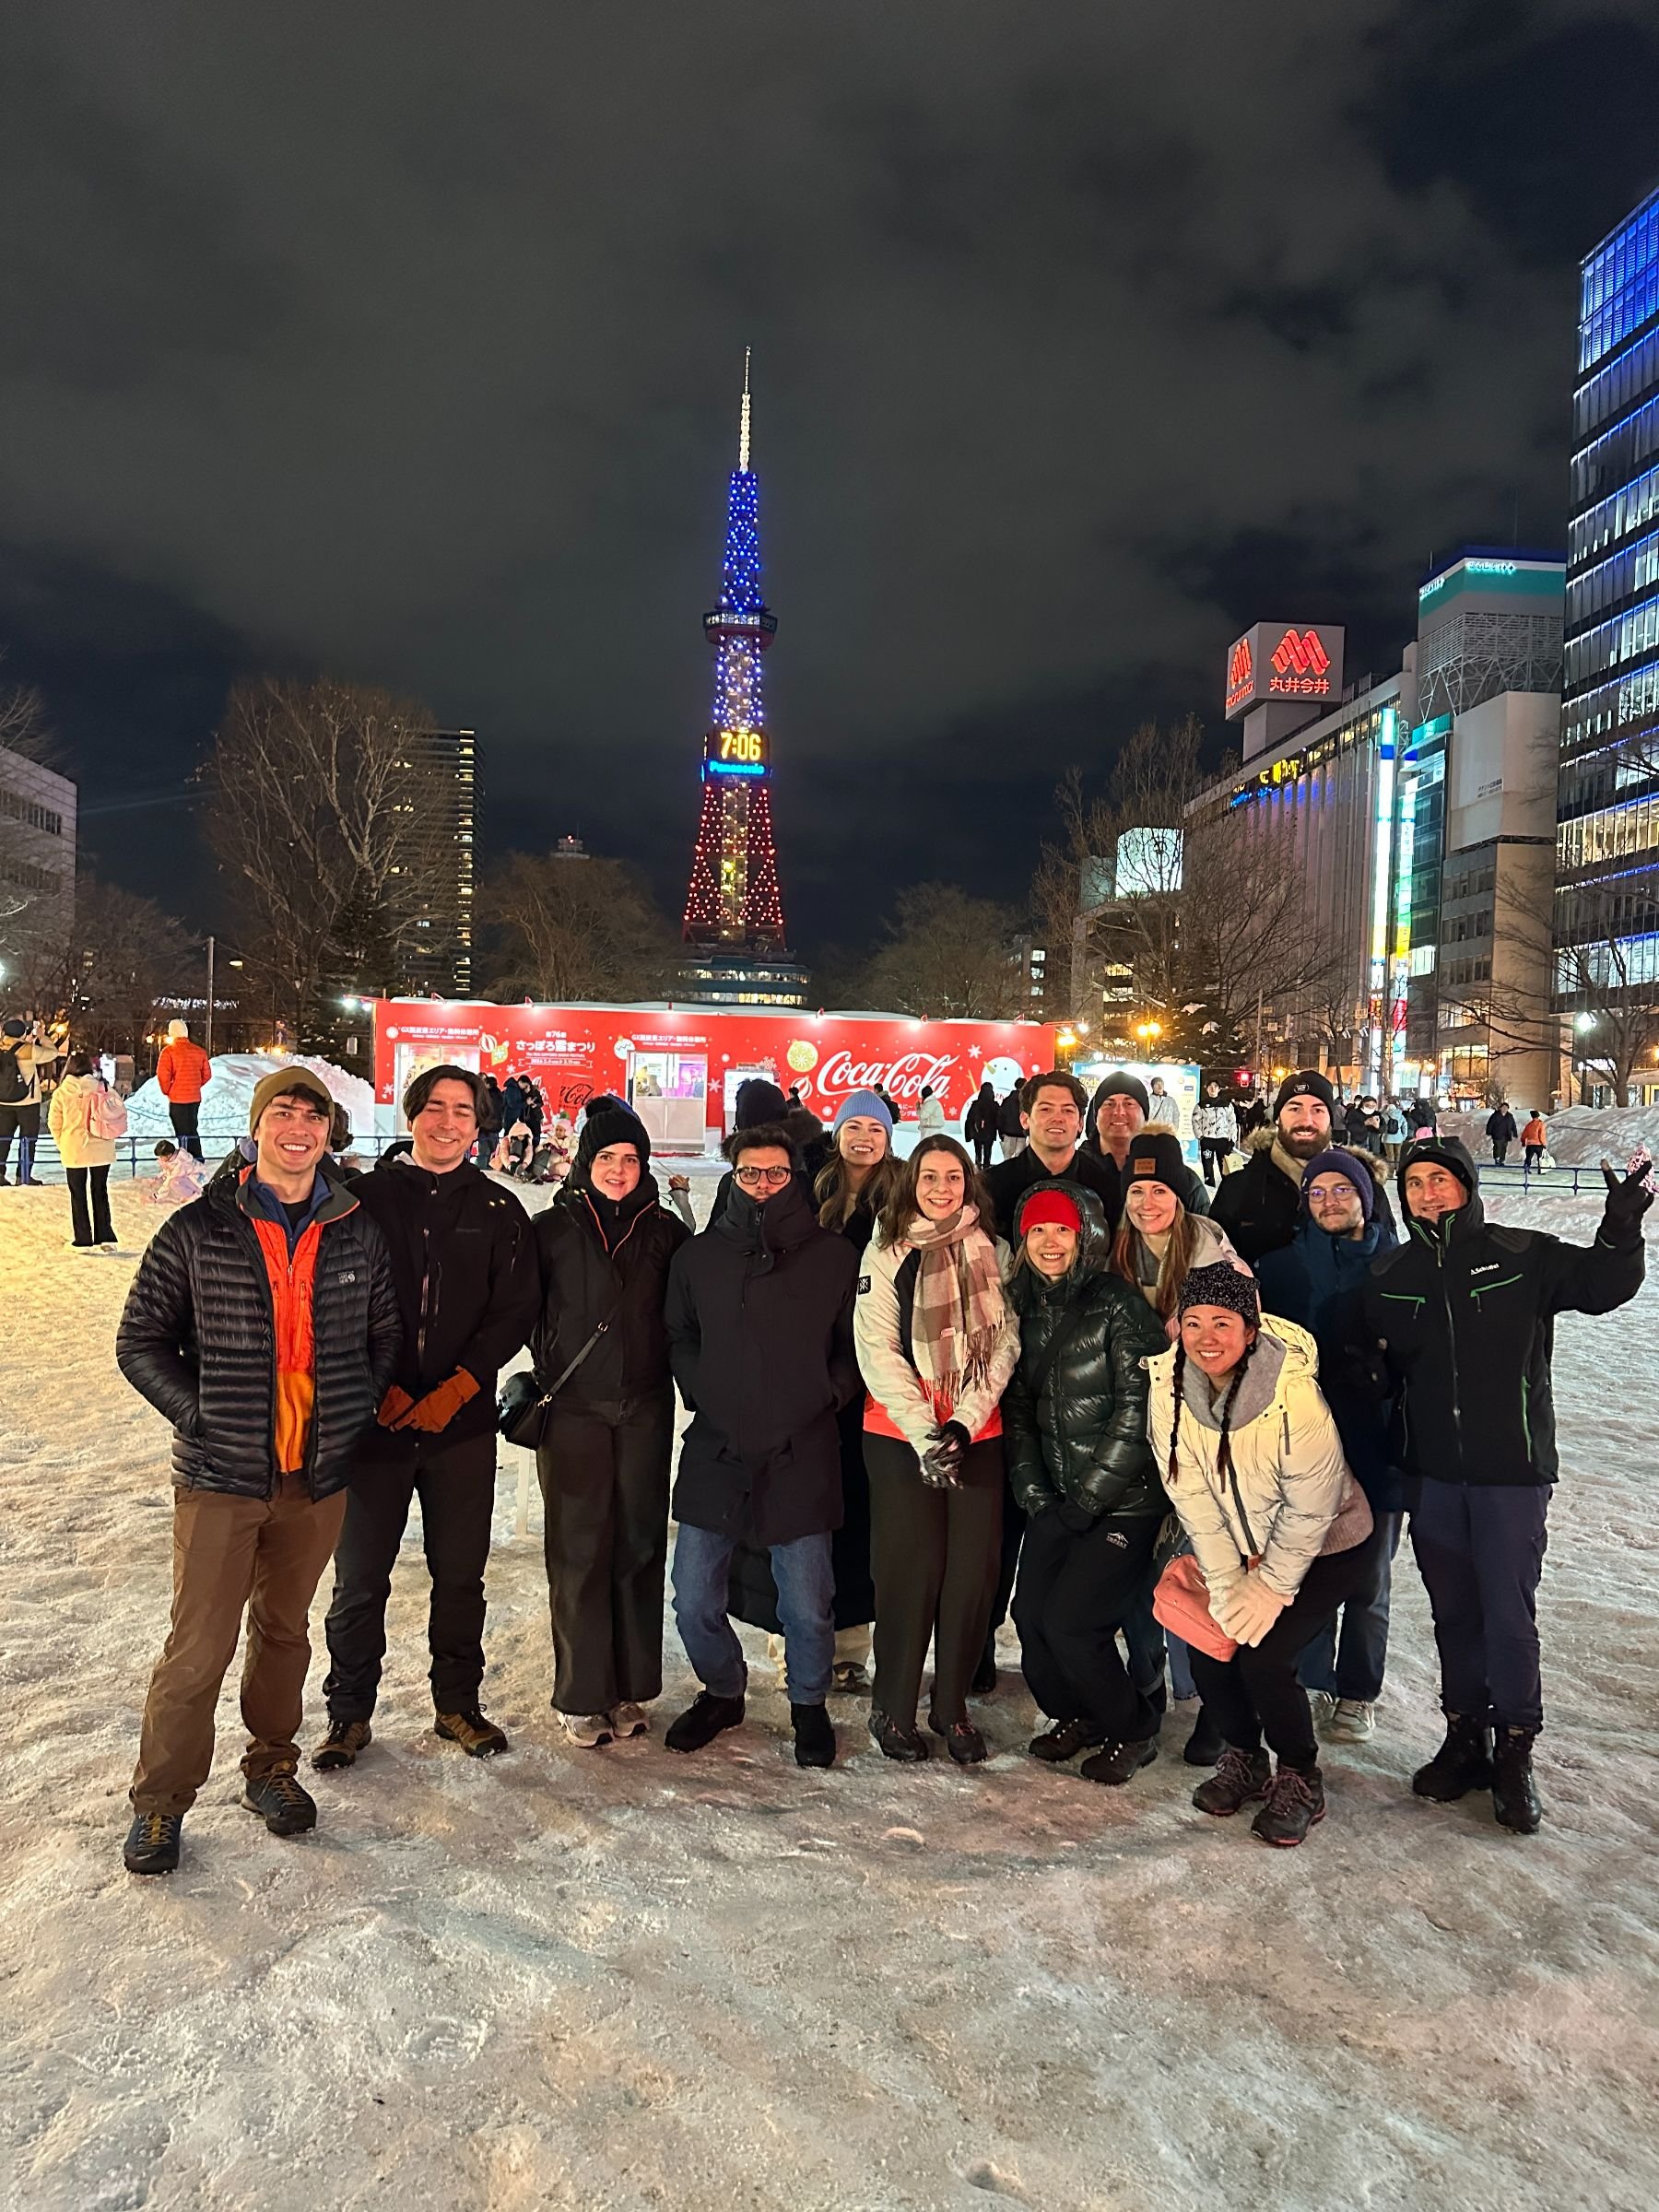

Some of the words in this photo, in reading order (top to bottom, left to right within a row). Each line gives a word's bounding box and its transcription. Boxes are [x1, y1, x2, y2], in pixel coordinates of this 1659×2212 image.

[1270, 677, 1329, 694] 丸井今井
[720, 732, 761, 760] 7:06
[709, 760, 765, 774] Panasonic
[516, 1040, 595, 1053] さっぽろ雪まつり
[817, 1051, 960, 1100] Coca-Cola
